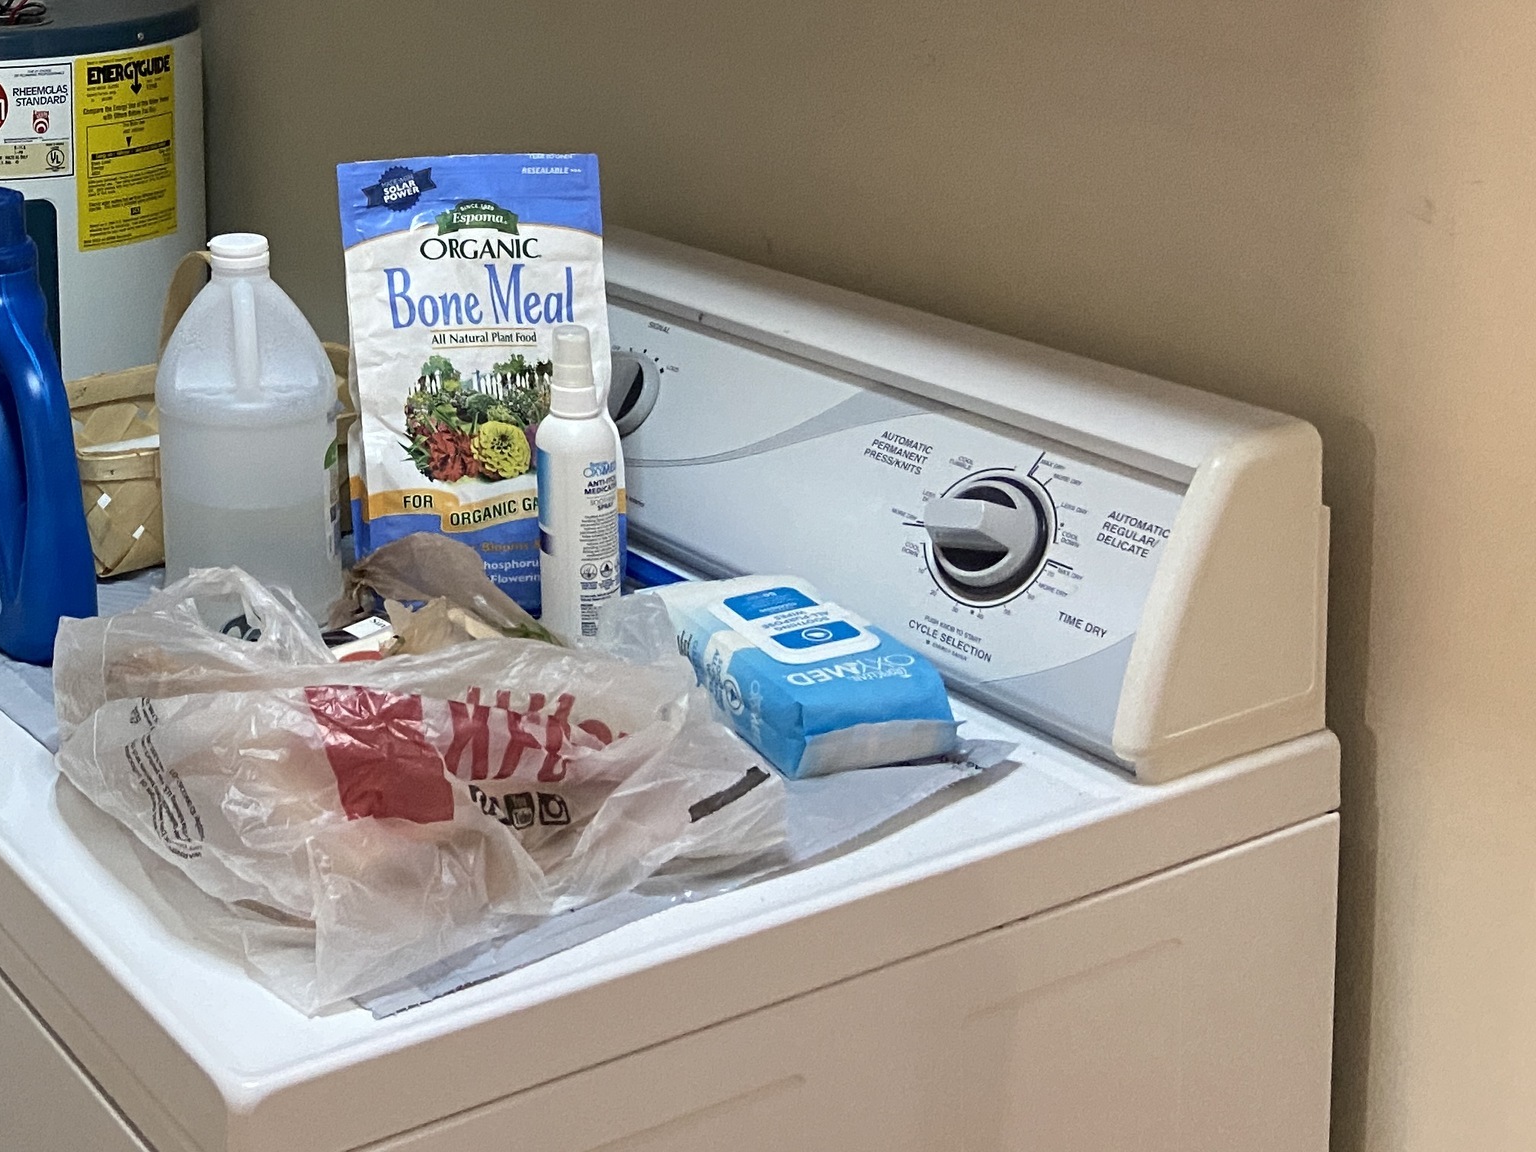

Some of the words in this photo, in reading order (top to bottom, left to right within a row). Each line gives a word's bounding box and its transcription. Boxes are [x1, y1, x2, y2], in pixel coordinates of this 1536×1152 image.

[12, 84, 69, 97] RHEEMGLAS
[15, 95, 67, 107] STANDARD
[521, 166, 569, 175] RESEALABLE
[383, 179, 417, 196] SOLAR
[383, 186, 420, 204] POWER
[452, 212, 504, 226] Espoma
[419, 237, 541, 260] ORGANIC
[383, 266, 483, 329] Bone
[484, 263, 575, 325] Meal
[647, 321, 671, 335] SIGNAL
[431, 333, 446, 344] All
[449, 332, 489, 344] Natural
[491, 331, 514, 343] Plant
[515, 332, 537, 344] Food
[881, 430, 934, 455] AUTOMATIC
[871, 438, 929, 465] PERMANENT
[863, 447, 923, 476] PRESS/KNITS
[403, 495, 434, 509] FOR
[1075, 505, 1088, 515] DRY
[449, 500, 517, 526] ORGANIC
[1107, 510, 1171, 539] AUTOMATIC
[1061, 531, 1079, 541] COOL
[1102, 521, 1161, 548] REGULAR/
[1096, 532, 1150, 558] DELICATE
[484, 559, 540, 572] hosphoru
[1038, 582, 1055, 592] MORE
[1055, 588, 1068, 598] DRY
[774, 610, 807, 620] WIPES
[773, 616, 830, 632] SOOTHING
[924, 615, 939, 625] PUSH
[939, 621, 955, 633] KNOB
[956, 628, 964, 636] TO
[964, 631, 982, 643] START
[1058, 610, 1083, 629] TIME
[1084, 622, 1108, 639] DRY
[908, 619, 939, 640] CYCLE
[939, 632, 993, 663] SELECTION
[786, 653, 916, 687] OXYMED
